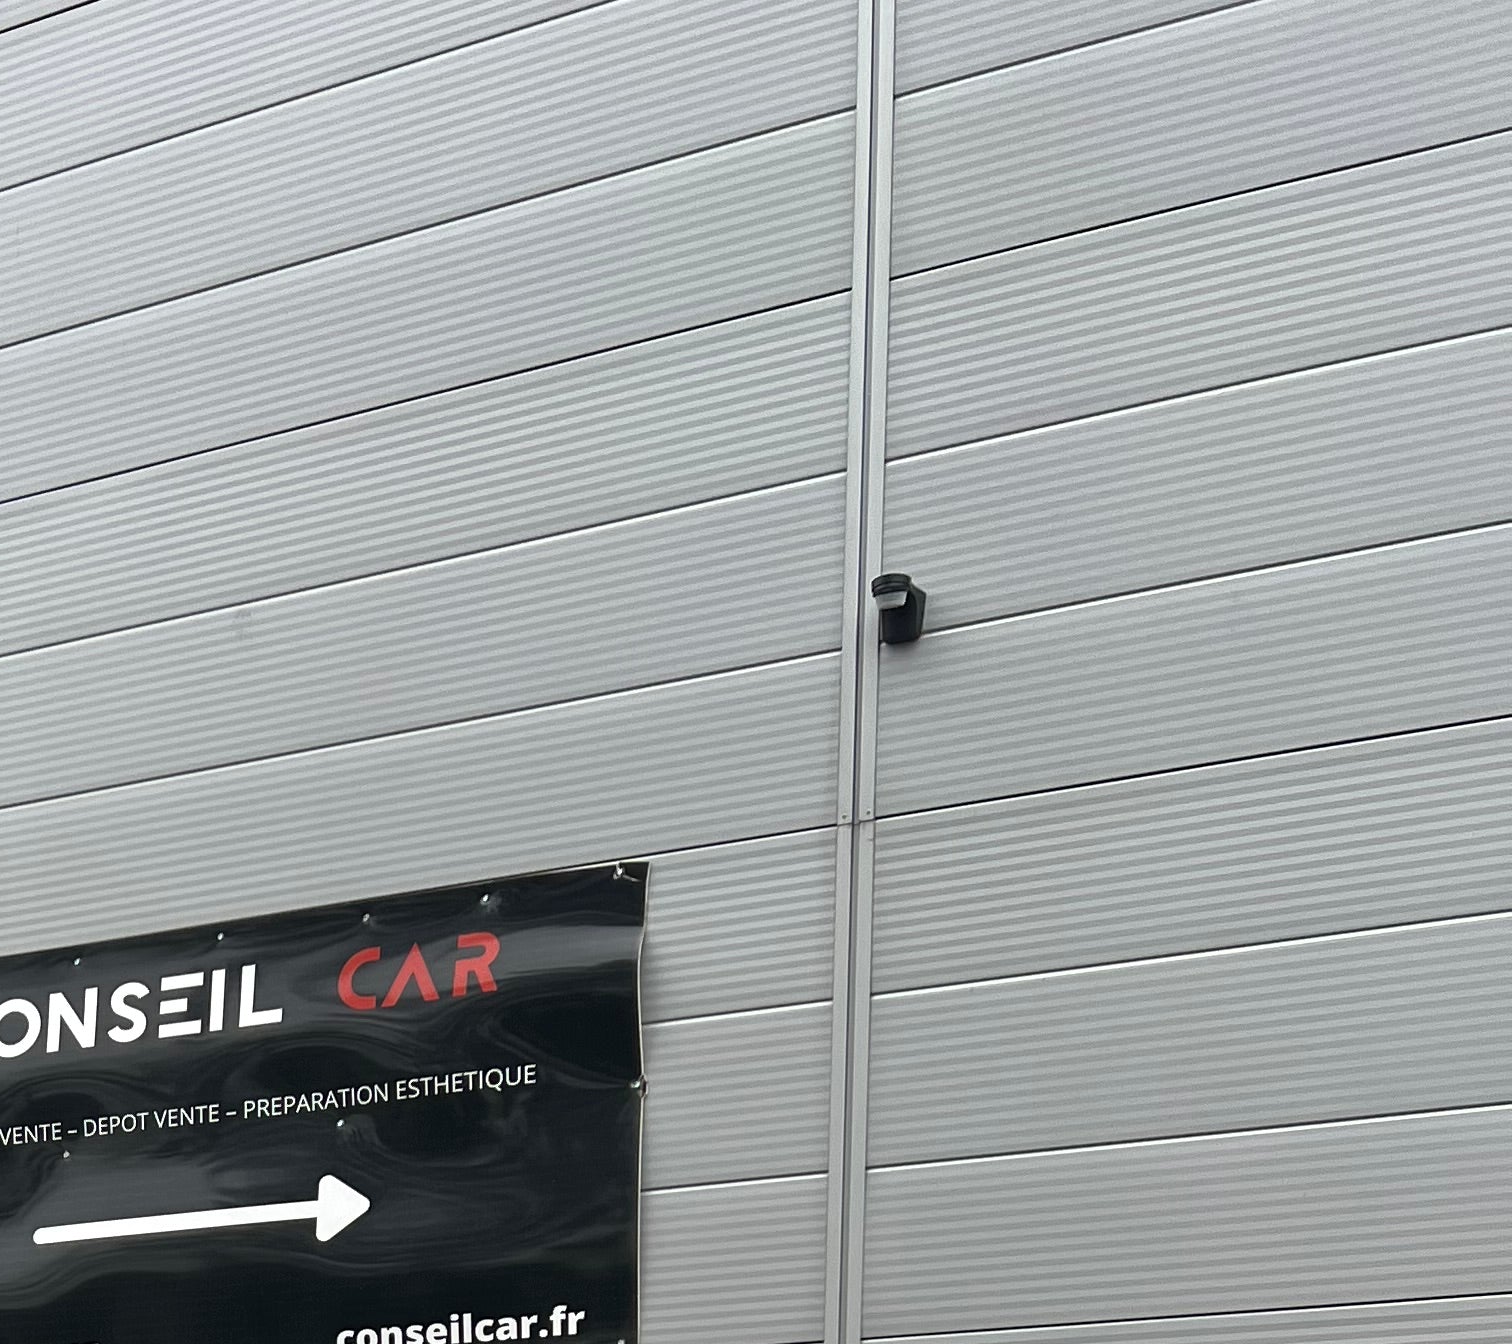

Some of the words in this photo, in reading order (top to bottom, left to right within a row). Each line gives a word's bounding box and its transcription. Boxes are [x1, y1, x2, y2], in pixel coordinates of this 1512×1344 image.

[338, 932, 500, 1011] CAR
[83, 1111, 149, 1137] DEPOT
[153, 1103, 220, 1129] VENTE
[243, 1082, 389, 1119] PREPARATION
[396, 1064, 537, 1100] ESTHETIQUE
